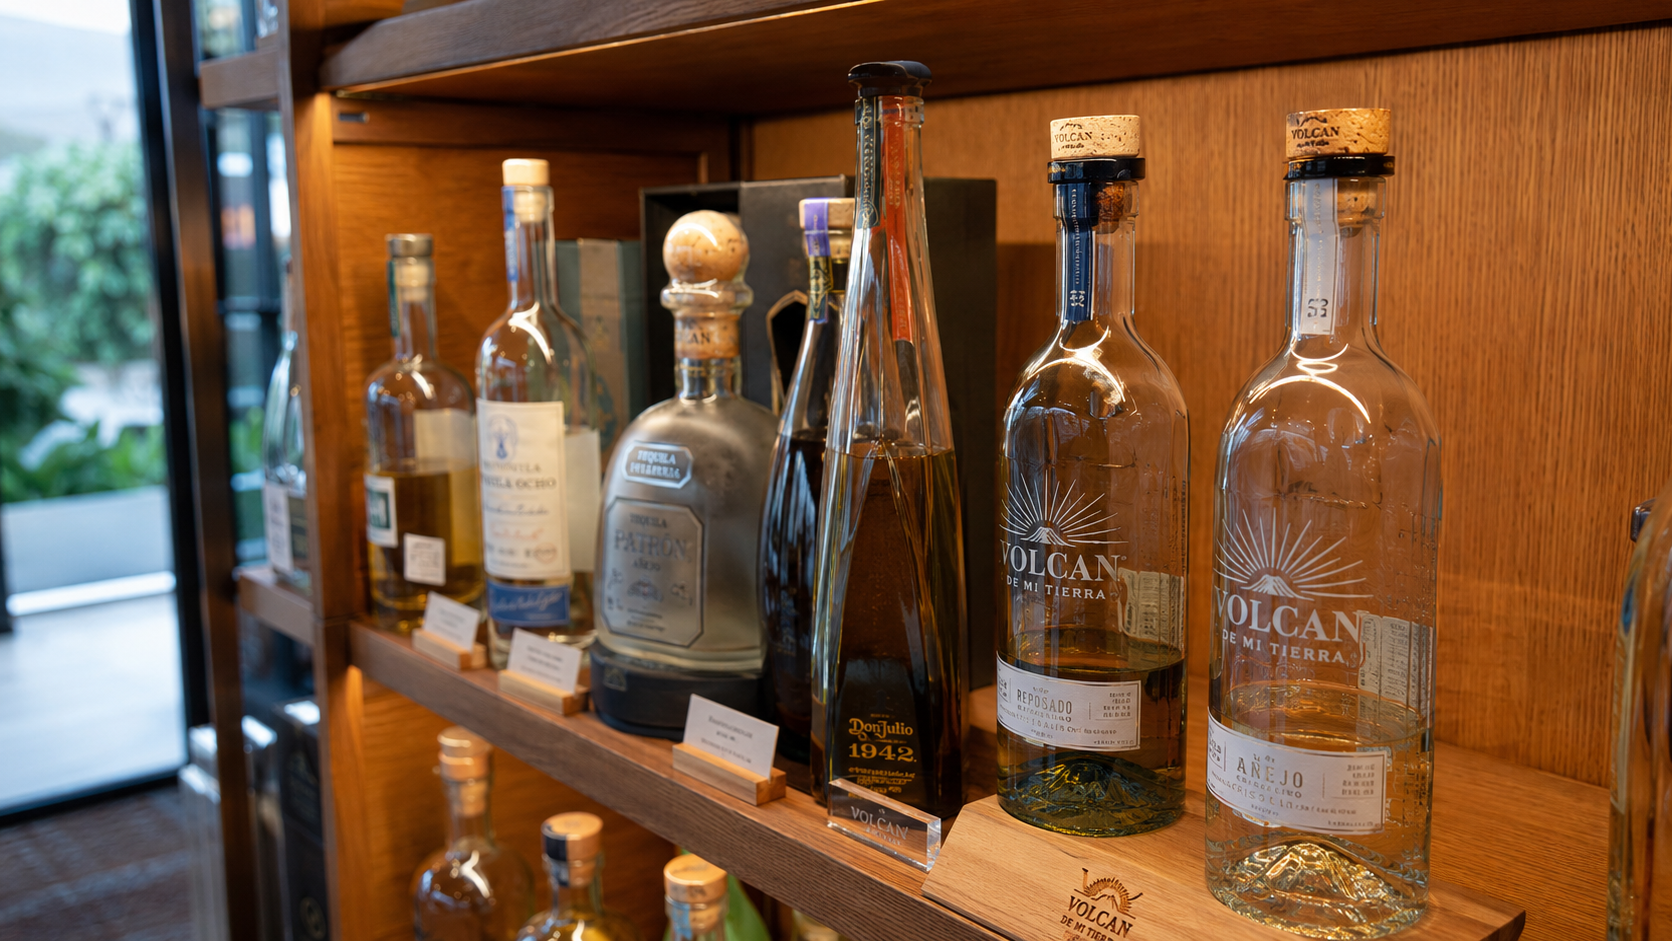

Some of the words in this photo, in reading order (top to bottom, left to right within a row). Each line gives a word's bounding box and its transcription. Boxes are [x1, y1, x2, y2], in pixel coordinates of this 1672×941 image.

[1292, 126, 1340, 140] VOLCAN
[1000, 538, 1121, 582] VOLCAN
[1006, 574, 1019, 588] DE
[1023, 580, 1039, 593] MI
[1045, 584, 1106, 600] TIERRA
[1214, 585, 1361, 644] VOLCAN
[1222, 628, 1237, 645] DE
[1242, 635, 1262, 652] MI
[1269, 642, 1346, 665] TIERRA
[1016, 688, 1073, 716] REPOSADO
[1236, 756, 1304, 790] AÑEJO
[851, 805, 909, 840] VOLCAN
[1059, 914, 1074, 928] DE
[1073, 920, 1087, 934] MI
[1067, 894, 1134, 939] VOLCAN
